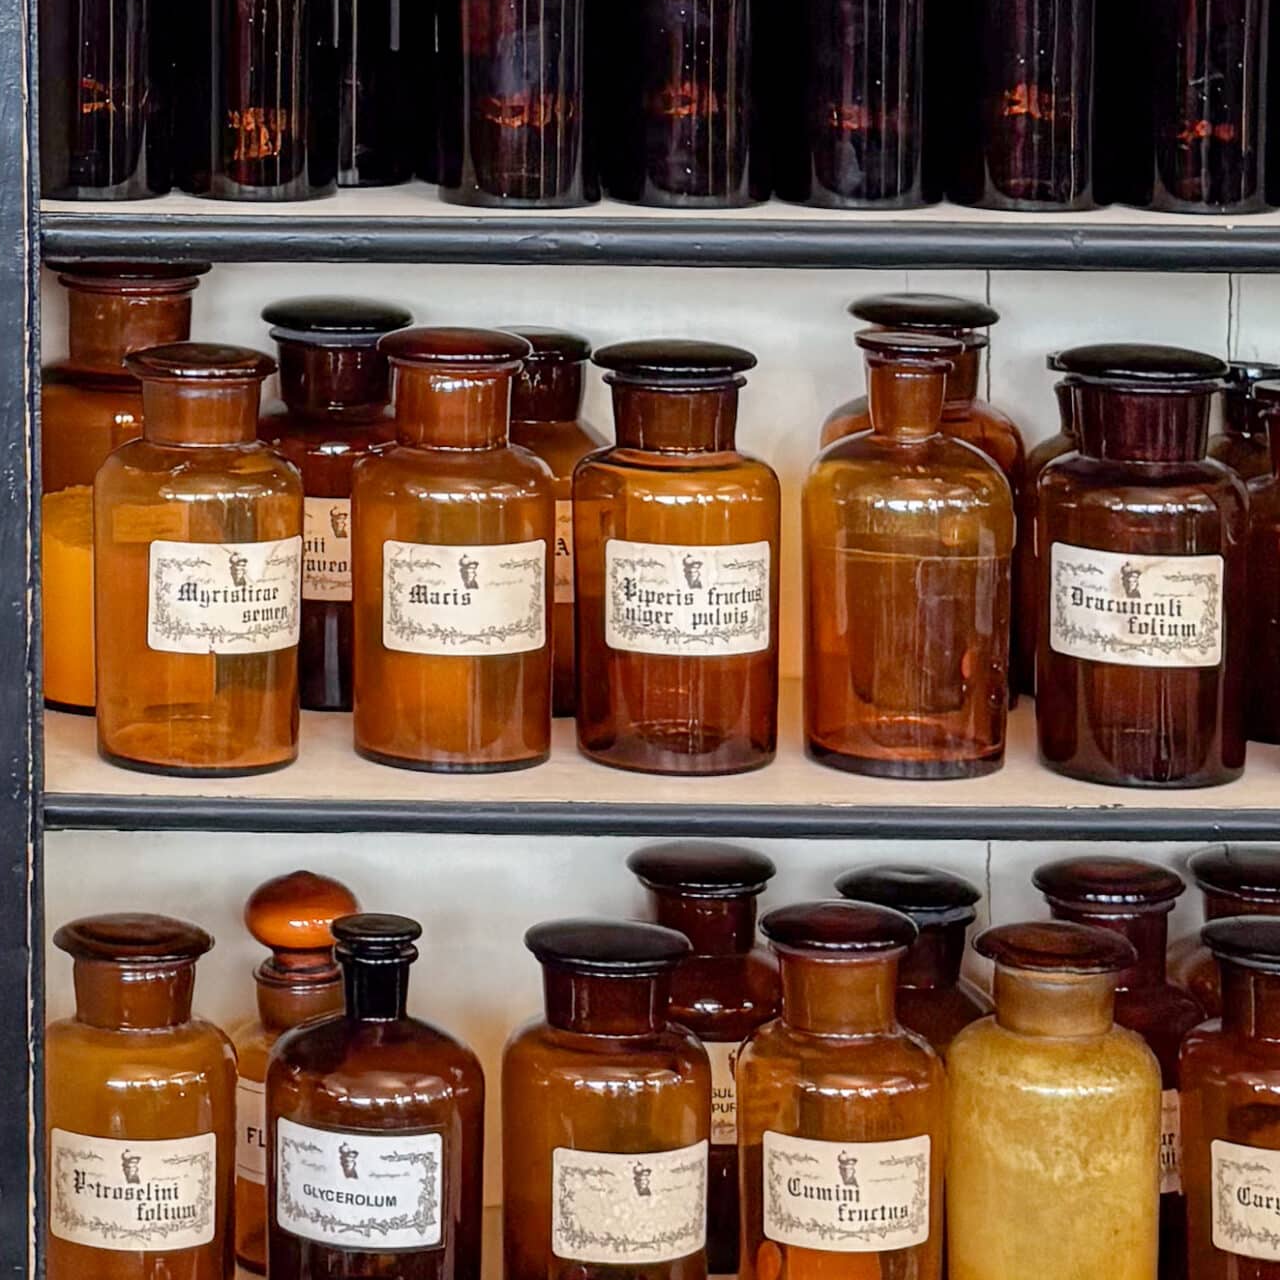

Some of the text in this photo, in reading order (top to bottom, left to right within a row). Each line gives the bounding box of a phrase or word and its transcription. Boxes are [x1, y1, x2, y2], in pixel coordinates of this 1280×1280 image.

[177, 581, 280, 608] Myristicae
[408, 583, 473, 607] Macis
[622, 576, 763, 607] Piperis fructus
[1070, 585, 1183, 617] Dracunculi
[242, 605, 290, 624] semen
[691, 607, 750, 631] pulvis
[1126, 615, 1198, 638] folium
[73, 1168, 180, 1202] Ptroselini
[302, 1182, 398, 1208] GLYCEROLUM
[787, 1176, 861, 1204] Cumini
[136, 1202, 198, 1222] folium
[837, 1203, 910, 1222] fructus
